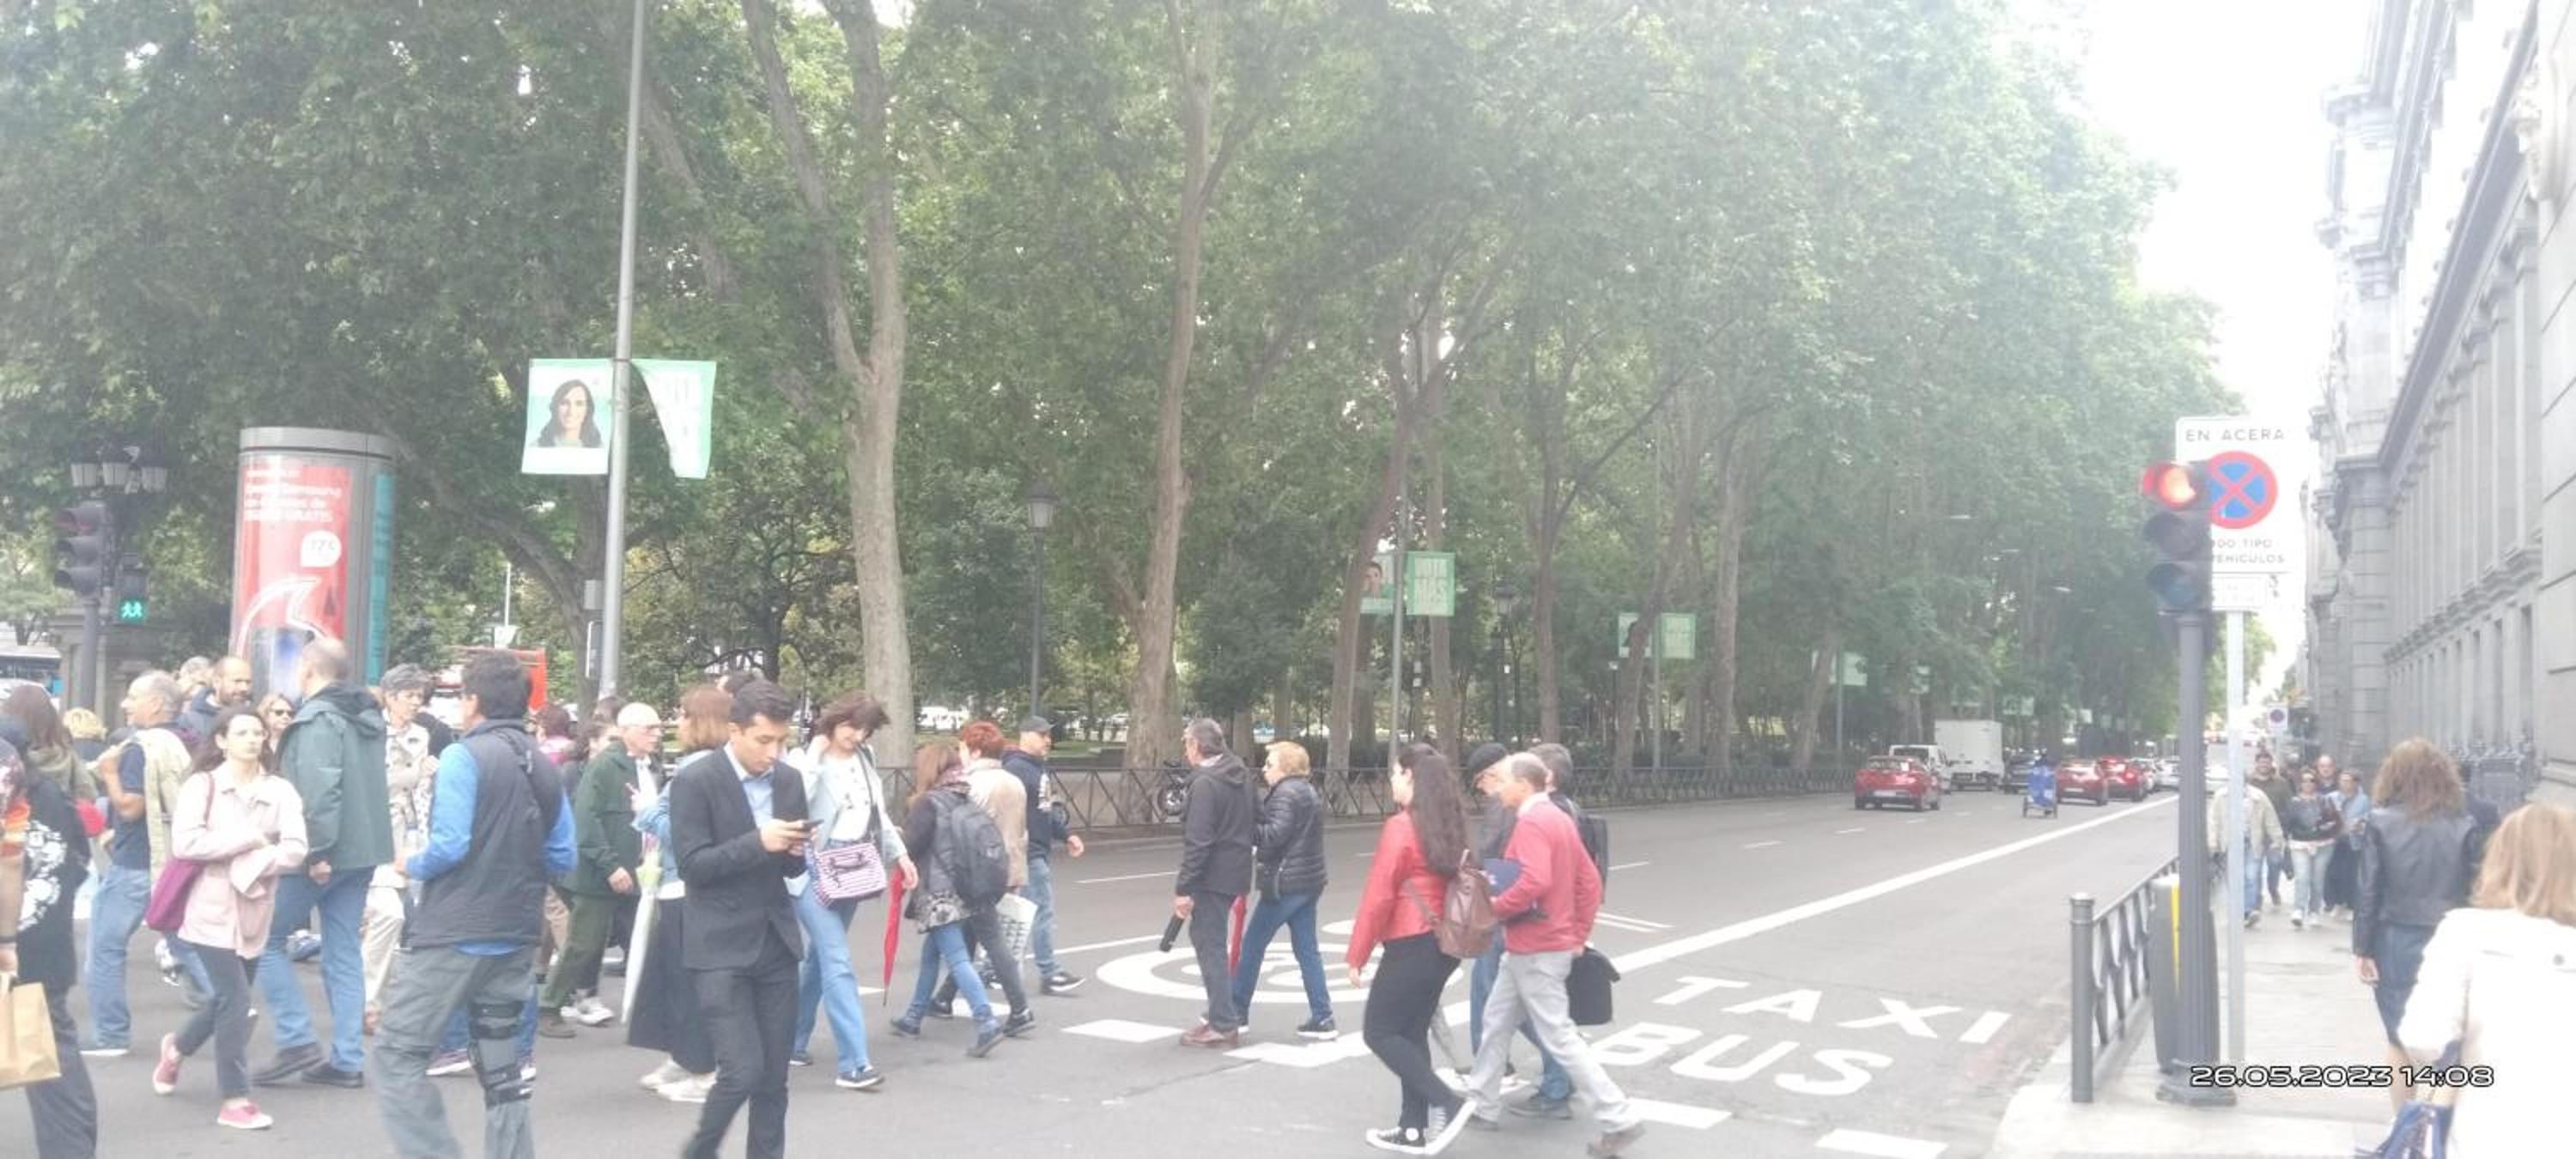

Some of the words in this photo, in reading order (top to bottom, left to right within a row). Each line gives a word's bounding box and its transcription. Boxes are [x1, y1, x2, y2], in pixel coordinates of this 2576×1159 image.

[2185, 428, 2210, 442] EN
[2221, 428, 2285, 441] ACERA
[2243, 538, 2273, 549] TIPO
[1653, 975, 2012, 1044] TAXI
[1587, 1022, 1894, 1096] BUS
